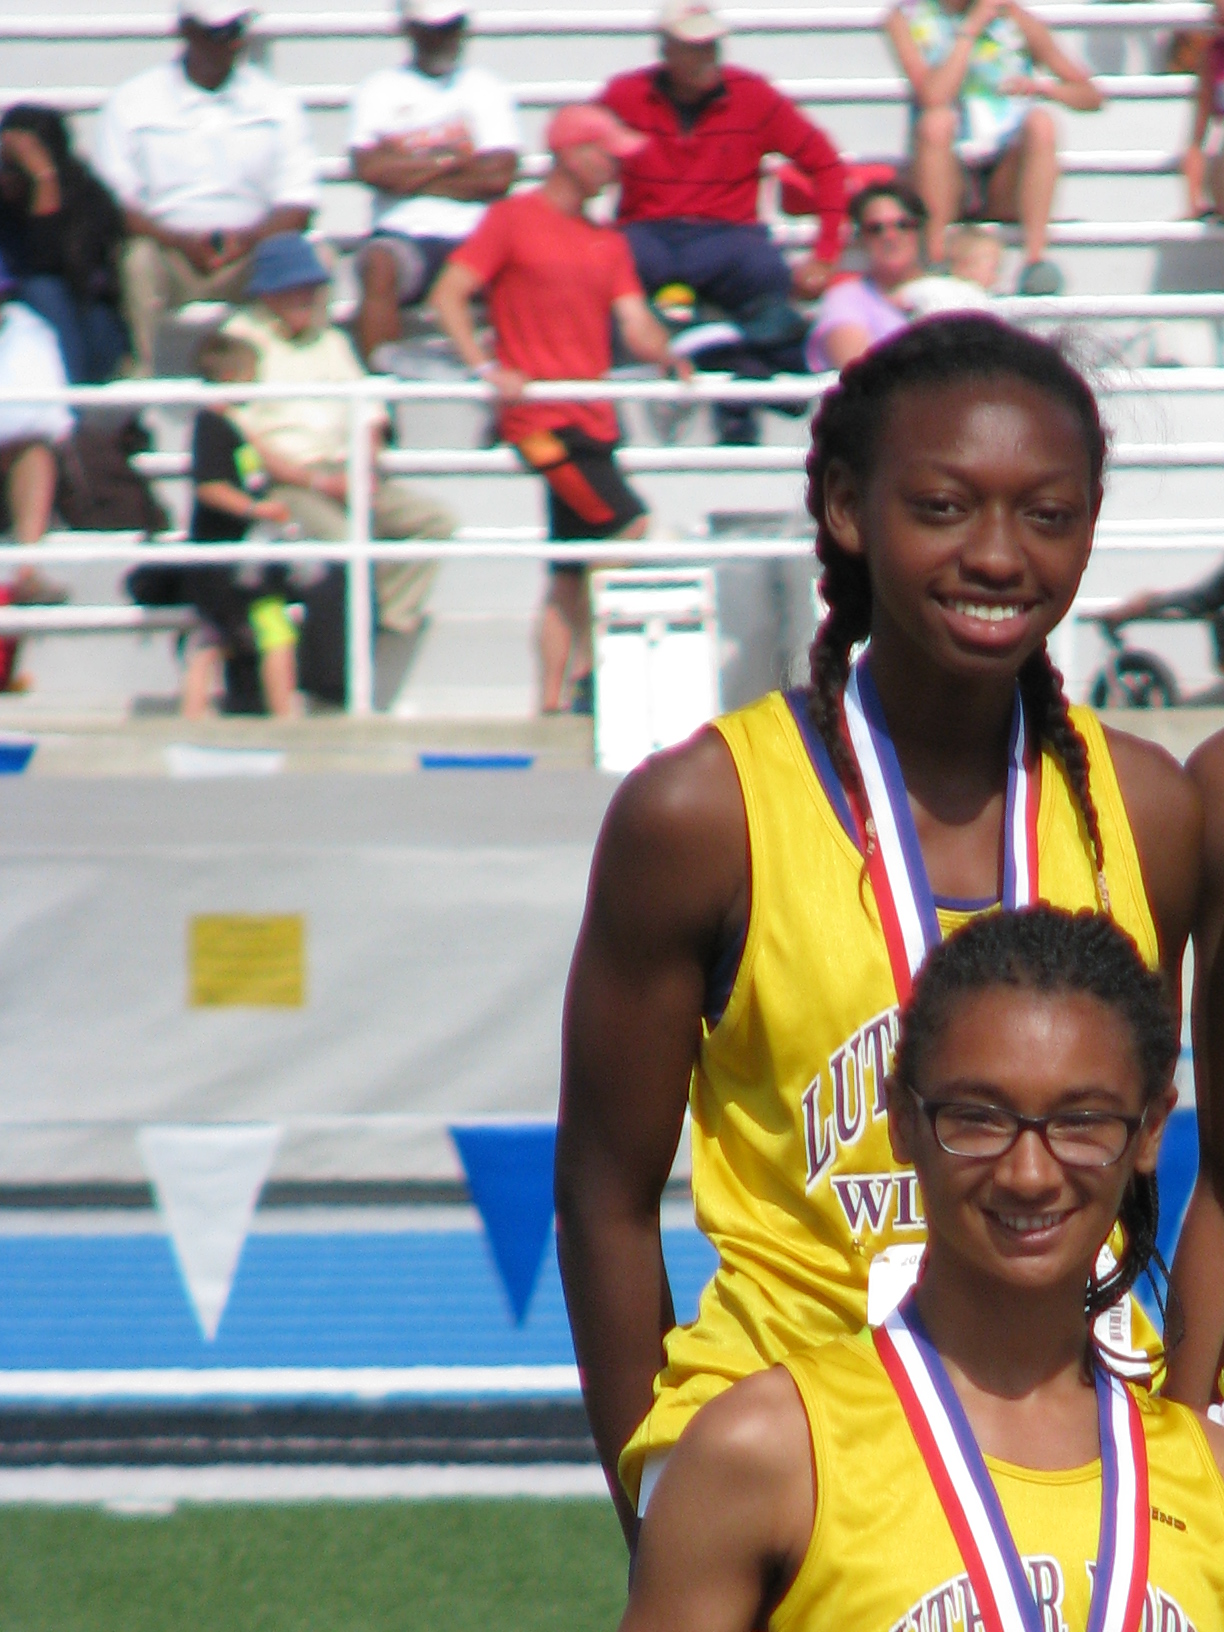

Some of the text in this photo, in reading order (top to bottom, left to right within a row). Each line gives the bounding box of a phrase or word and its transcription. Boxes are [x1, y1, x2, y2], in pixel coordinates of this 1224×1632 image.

[802, 1003, 901, 1197] LUT
[830, 1170, 928, 1236] WI
[1150, 1505, 1187, 1533] IND
